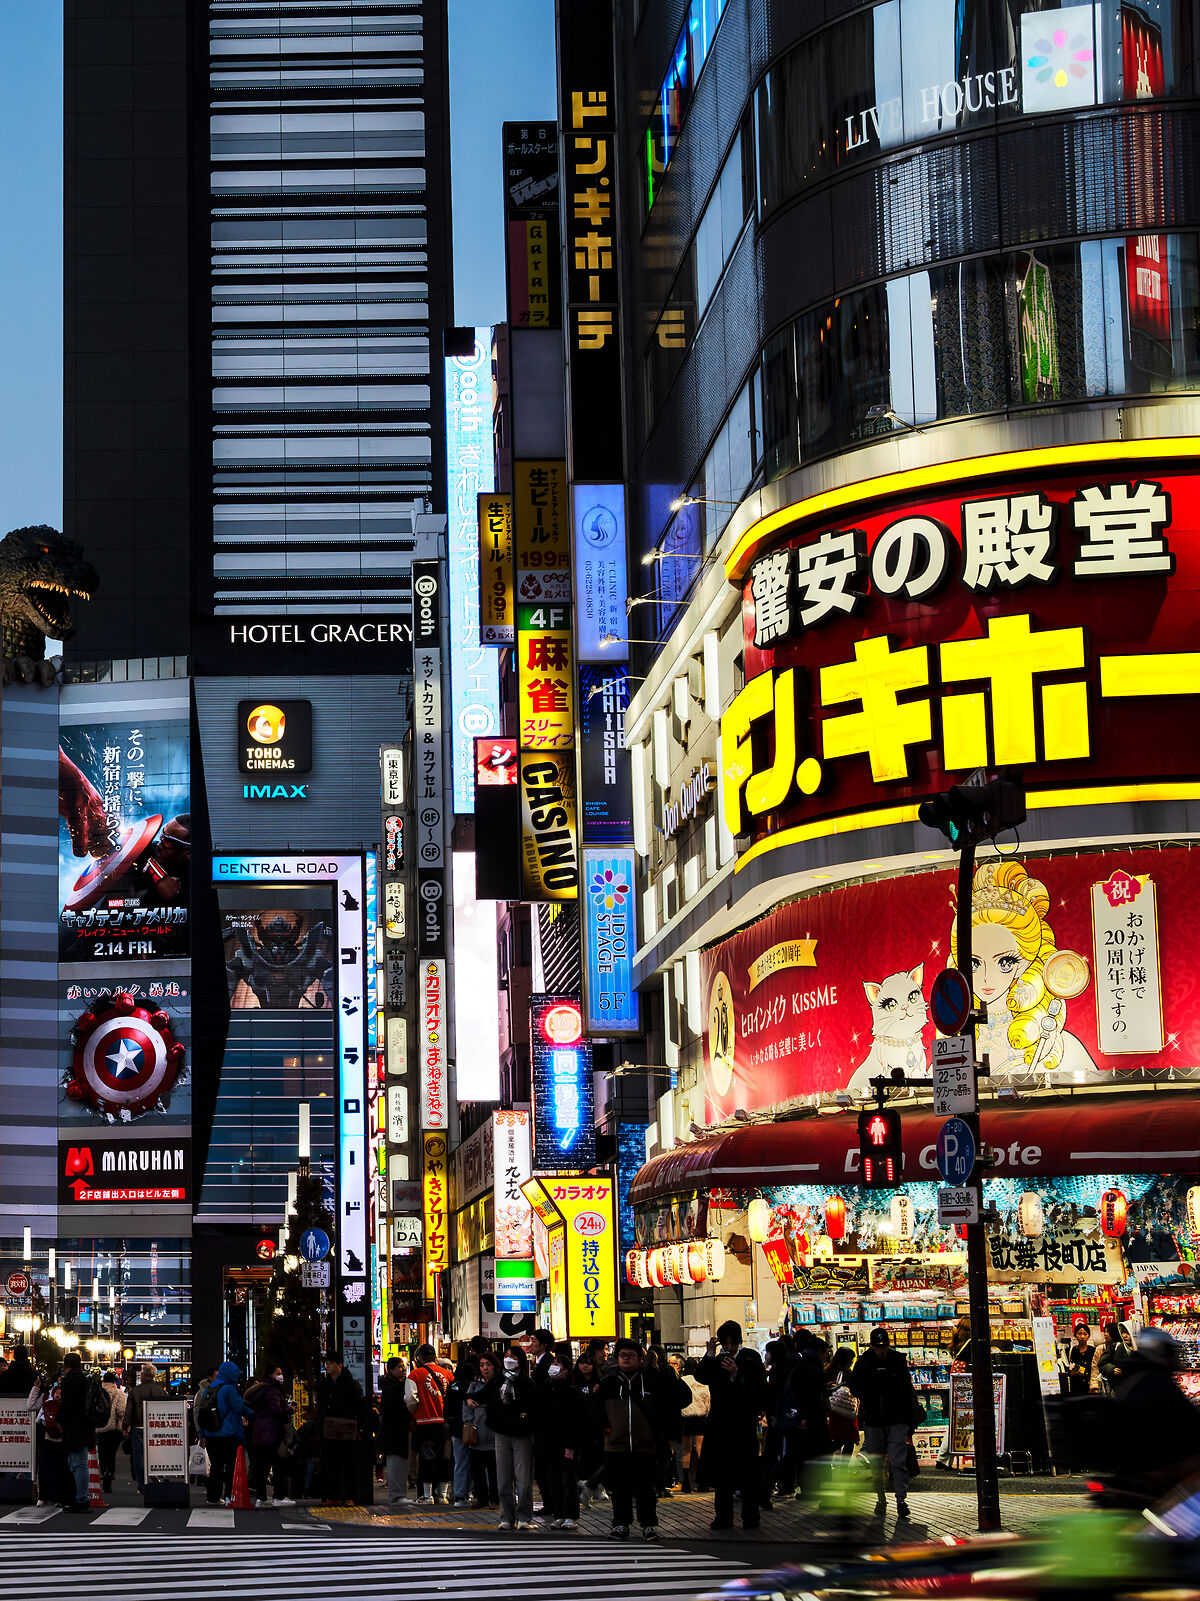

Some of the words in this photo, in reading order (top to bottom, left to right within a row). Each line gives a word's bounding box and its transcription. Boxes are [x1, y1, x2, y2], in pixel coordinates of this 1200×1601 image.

[845, 97, 901, 152] LIVE
[919, 66, 1021, 124] HOUSE
[528, 468, 550, 545] 生ビール
[487, 502, 505, 563] 生ビール
[519, 550, 570, 568] 199円
[751, 483, 1173, 648] 驚安の殿堂
[414, 575, 438, 636] Booth
[493, 565, 507, 621] 199円
[230, 624, 306, 643] HOTEL
[310, 623, 414, 643] GRACERY
[529, 608, 564, 629] 4F
[421, 655, 436, 726] ネットカフェ
[526, 636, 570, 714] 麻雀
[423, 732, 436, 744] &
[522, 718, 563, 732] スリー
[127, 728, 145, 808] その一撃に、
[246, 747, 282, 759] TOHO
[246, 758, 296, 770] CINEMAS
[243, 785, 307, 799] IMAX
[387, 759, 399, 800] 東京ビル
[422, 750, 436, 799] カプセル
[103, 746, 122, 852] 新宿が揺らぐ。
[663, 801, 681, 841] Don
[680, 760, 711, 821] Quijote
[522, 761, 578, 891] CASINO
[219, 863, 291, 875] CENTRAL
[299, 862, 339, 874] ROAD
[1109, 879, 1132, 900] 祝
[420, 879, 443, 942] Booth
[93, 942, 124, 956] 2.14
[128, 941, 157, 955] FRI.
[596, 913, 613, 974] STAGE
[612, 912, 627, 964] IDOL
[1125, 910, 1147, 1001] おかげ様で
[425, 974, 441, 1033] カラオケ
[599, 992, 627, 1011] 5F
[1103, 928, 1132, 1041] 20周年ですの。
[740, 994, 787, 1039] ヒロインメイク
[750, 1028, 823, 1066] いかなる時も完璧に美しく
[340, 946, 361, 1217] ゴジラロード
[426, 1045, 443, 1127] まねきねこ
[102, 1149, 185, 1172] MARUHAN
[944, 1134, 959, 1176] P
[954, 1156, 966, 1175] 40
[504, 1165, 521, 1201] 九十九
[553, 1185, 611, 1201] カラオケ
[579, 1216, 603, 1232] 24H
[987, 1235, 1108, 1273] 歌舞伎町店
[1135, 1264, 1160, 1273] JAPAN
[497, 1282, 534, 1291] FamilyMart
[895, 1279, 927, 1289] JAPAN
